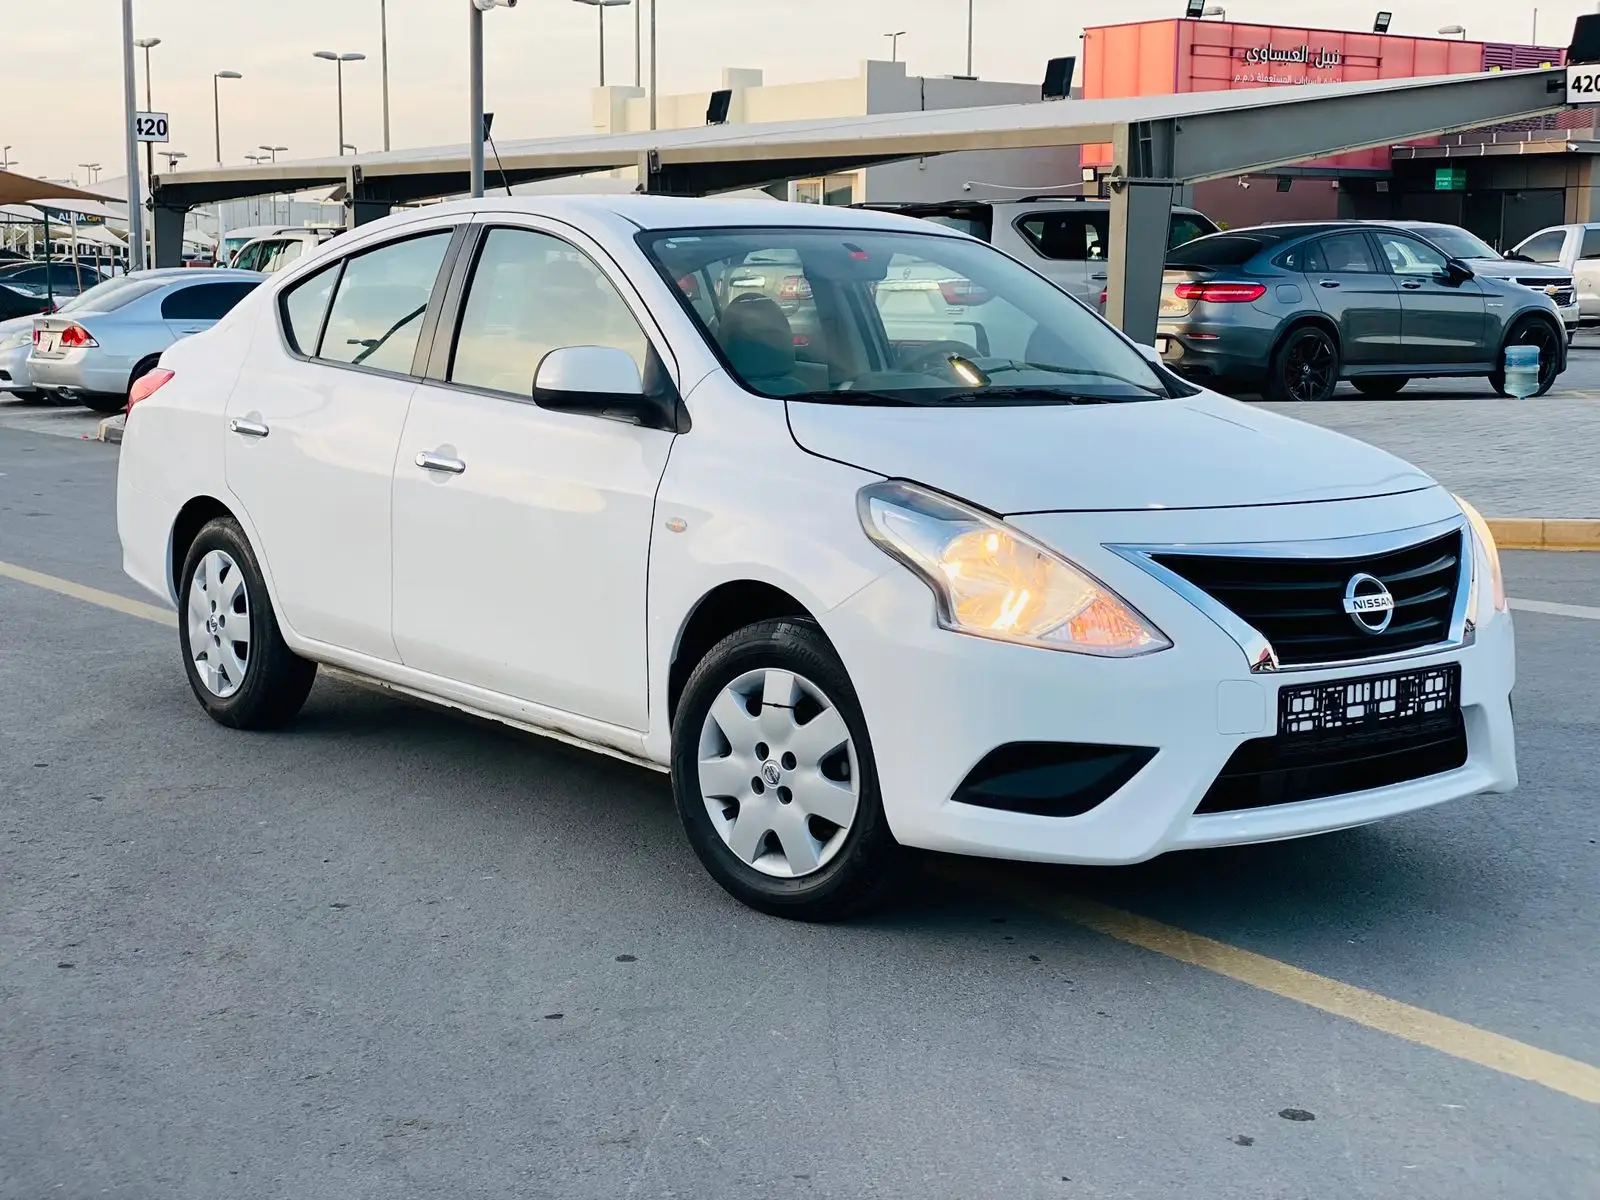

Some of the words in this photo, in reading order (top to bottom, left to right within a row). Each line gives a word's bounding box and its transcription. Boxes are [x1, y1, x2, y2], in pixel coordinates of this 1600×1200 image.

[1315, 46, 1340, 68] نبيل
[136, 117, 168, 136] 420
[1352, 596, 1393, 610] NISSAN
